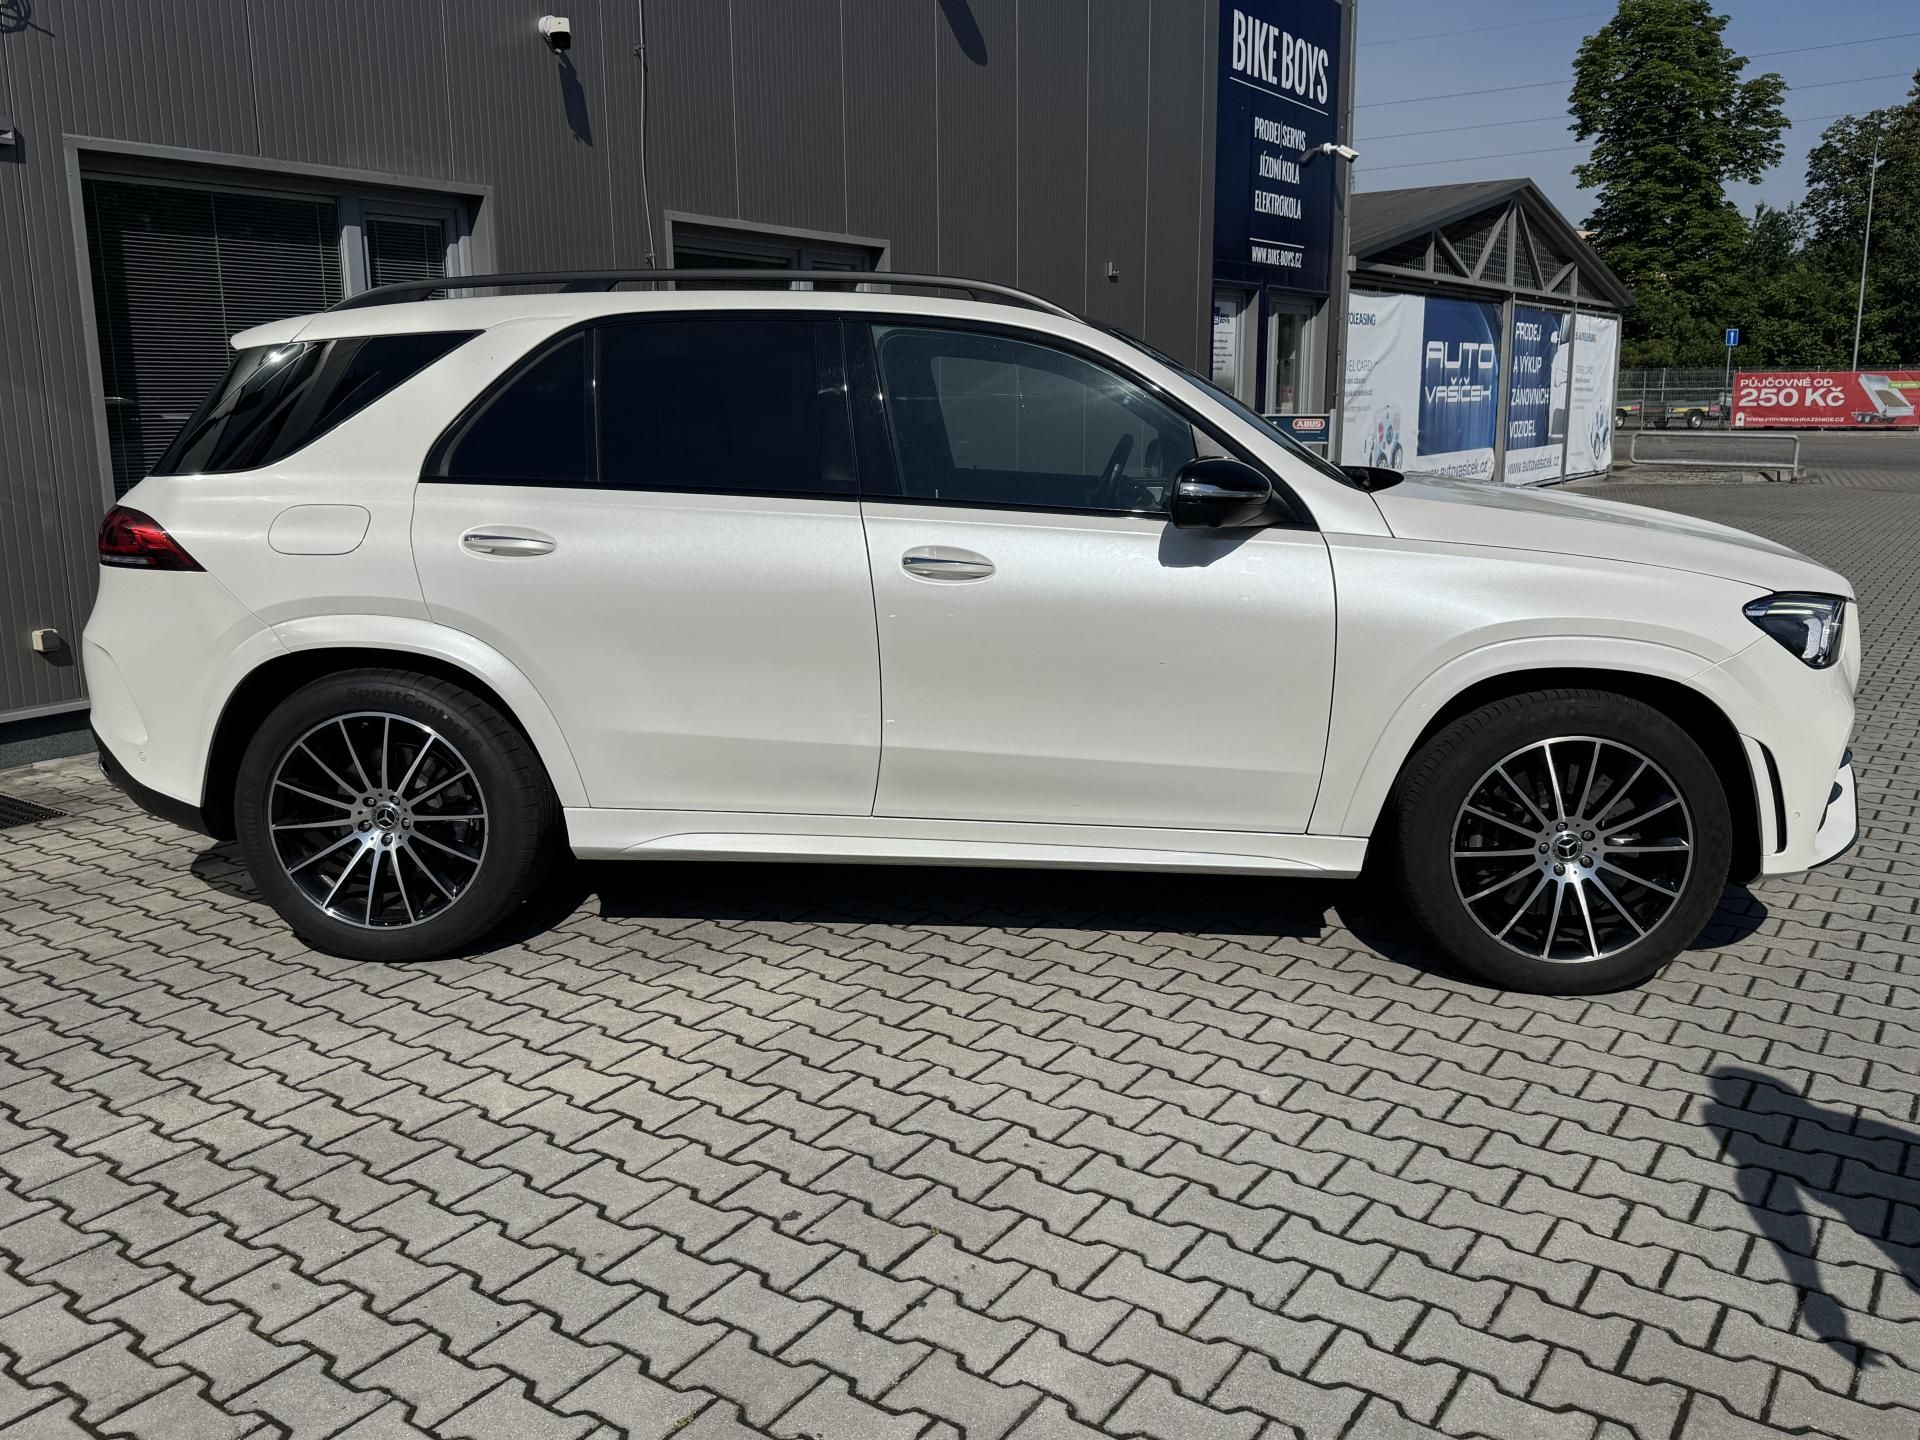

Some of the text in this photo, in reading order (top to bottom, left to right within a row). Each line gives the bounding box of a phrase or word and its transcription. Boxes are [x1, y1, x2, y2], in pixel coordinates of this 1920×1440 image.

[1232, 9, 1329, 105] BIKE BOYS
[1259, 150, 1300, 185] JÍZDNÍ KOLA
[1254, 190, 1301, 220] ELEKTROKOLA
[1251, 246, 1303, 269] WWW.BIKE-BOYS.CZ
[1515, 322, 1542, 341] PRODEJ
[1426, 341, 1494, 369] AUTO
[1513, 352, 1542, 374] A VÝKUP
[1425, 376, 1492, 403] VAŠÍČEK
[1740, 376, 1833, 387] PŮJČOVNÉ OD
[1511, 385, 1550, 405] ZÁNOVNÍCH
[1739, 386, 1845, 407] 250 Kč
[1296, 420, 1321, 428] ABUS
[1509, 420, 1536, 438] VOZIDEL
